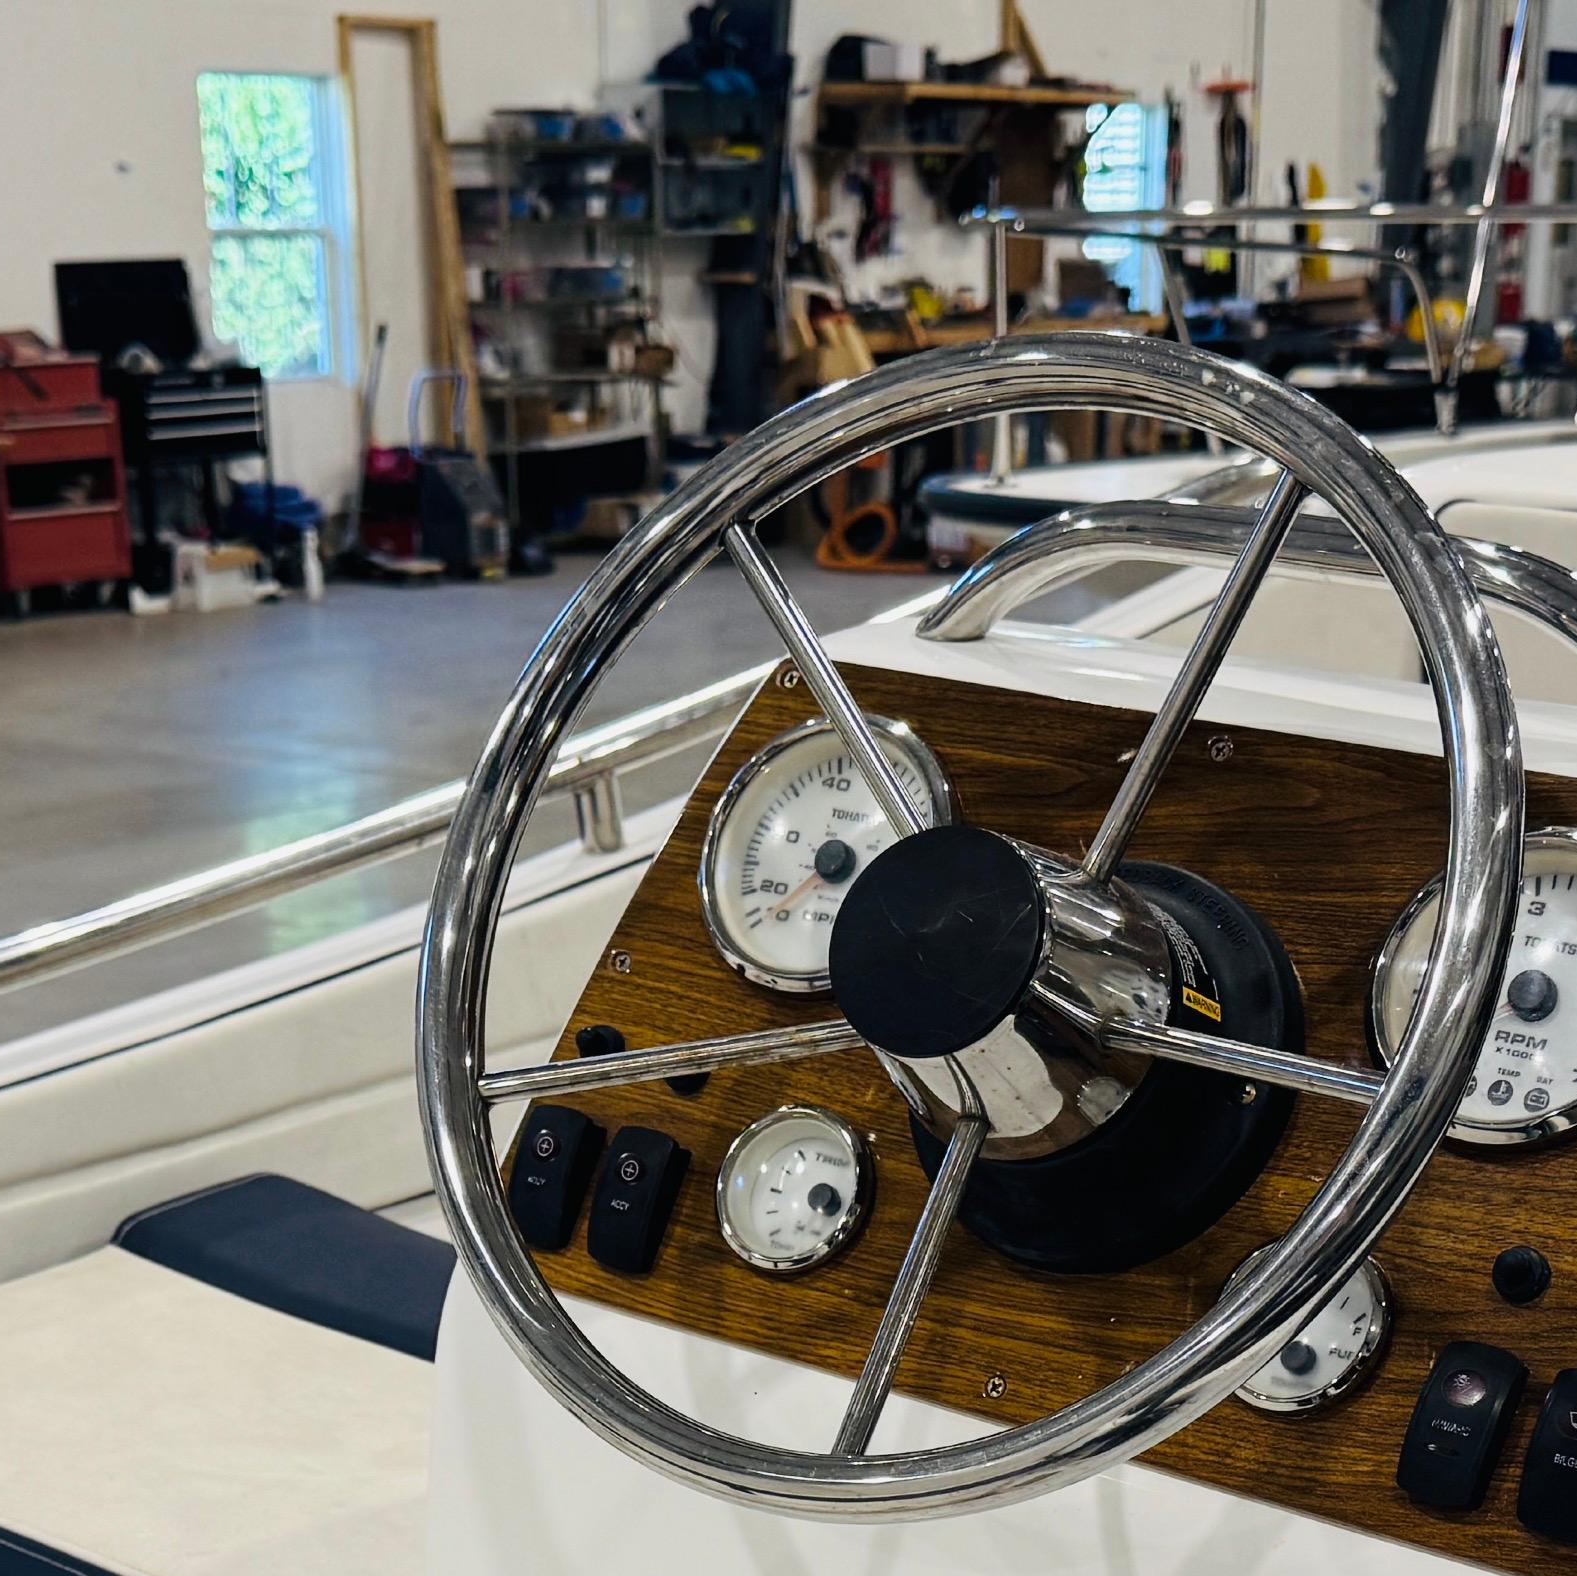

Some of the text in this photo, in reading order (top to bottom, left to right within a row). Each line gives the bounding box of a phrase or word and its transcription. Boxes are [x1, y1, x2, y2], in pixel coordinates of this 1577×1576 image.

[821, 776, 851, 792] 40
[832, 808, 878, 824] TOHAT
[759, 879, 789, 896] 20
[1527, 900, 1546, 916] 3
[1494, 1029, 1549, 1051] RPM
[1497, 1067, 1522, 1078] TEMP
[1351, 1326, 1362, 1337] F
